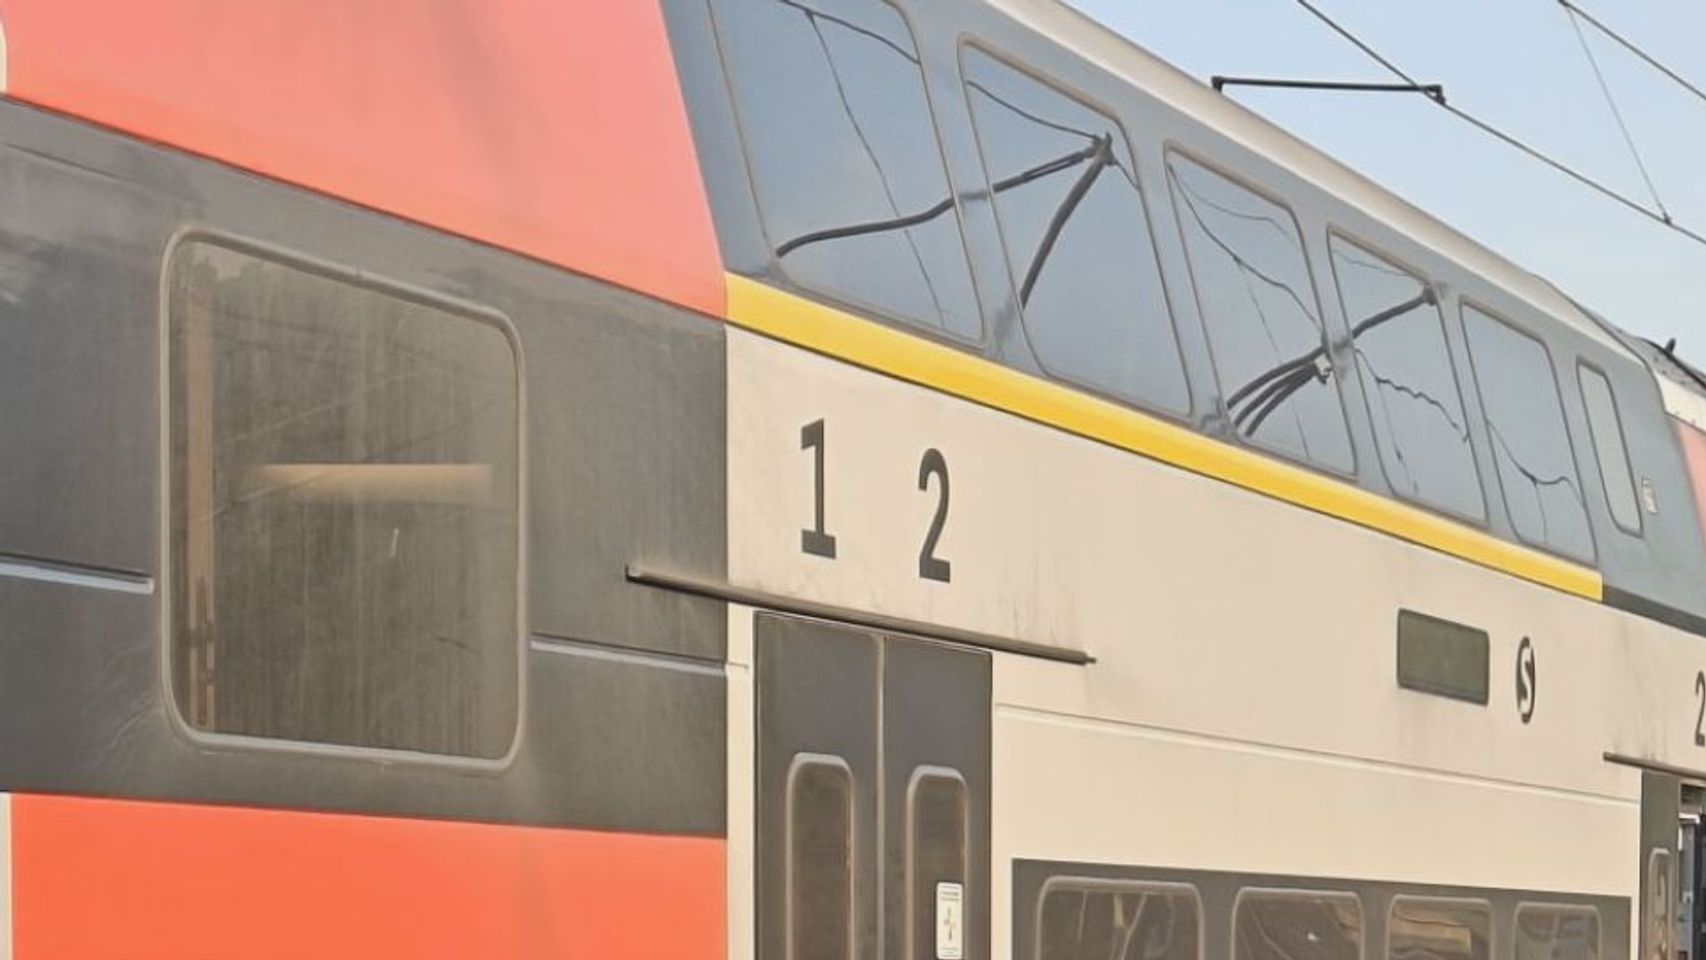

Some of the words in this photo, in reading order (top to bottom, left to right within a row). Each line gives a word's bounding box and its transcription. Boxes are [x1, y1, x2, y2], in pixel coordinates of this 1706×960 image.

[800, 418, 836, 560] 1
[918, 447, 951, 584] 2
[1694, 671, 1706, 748] 2
